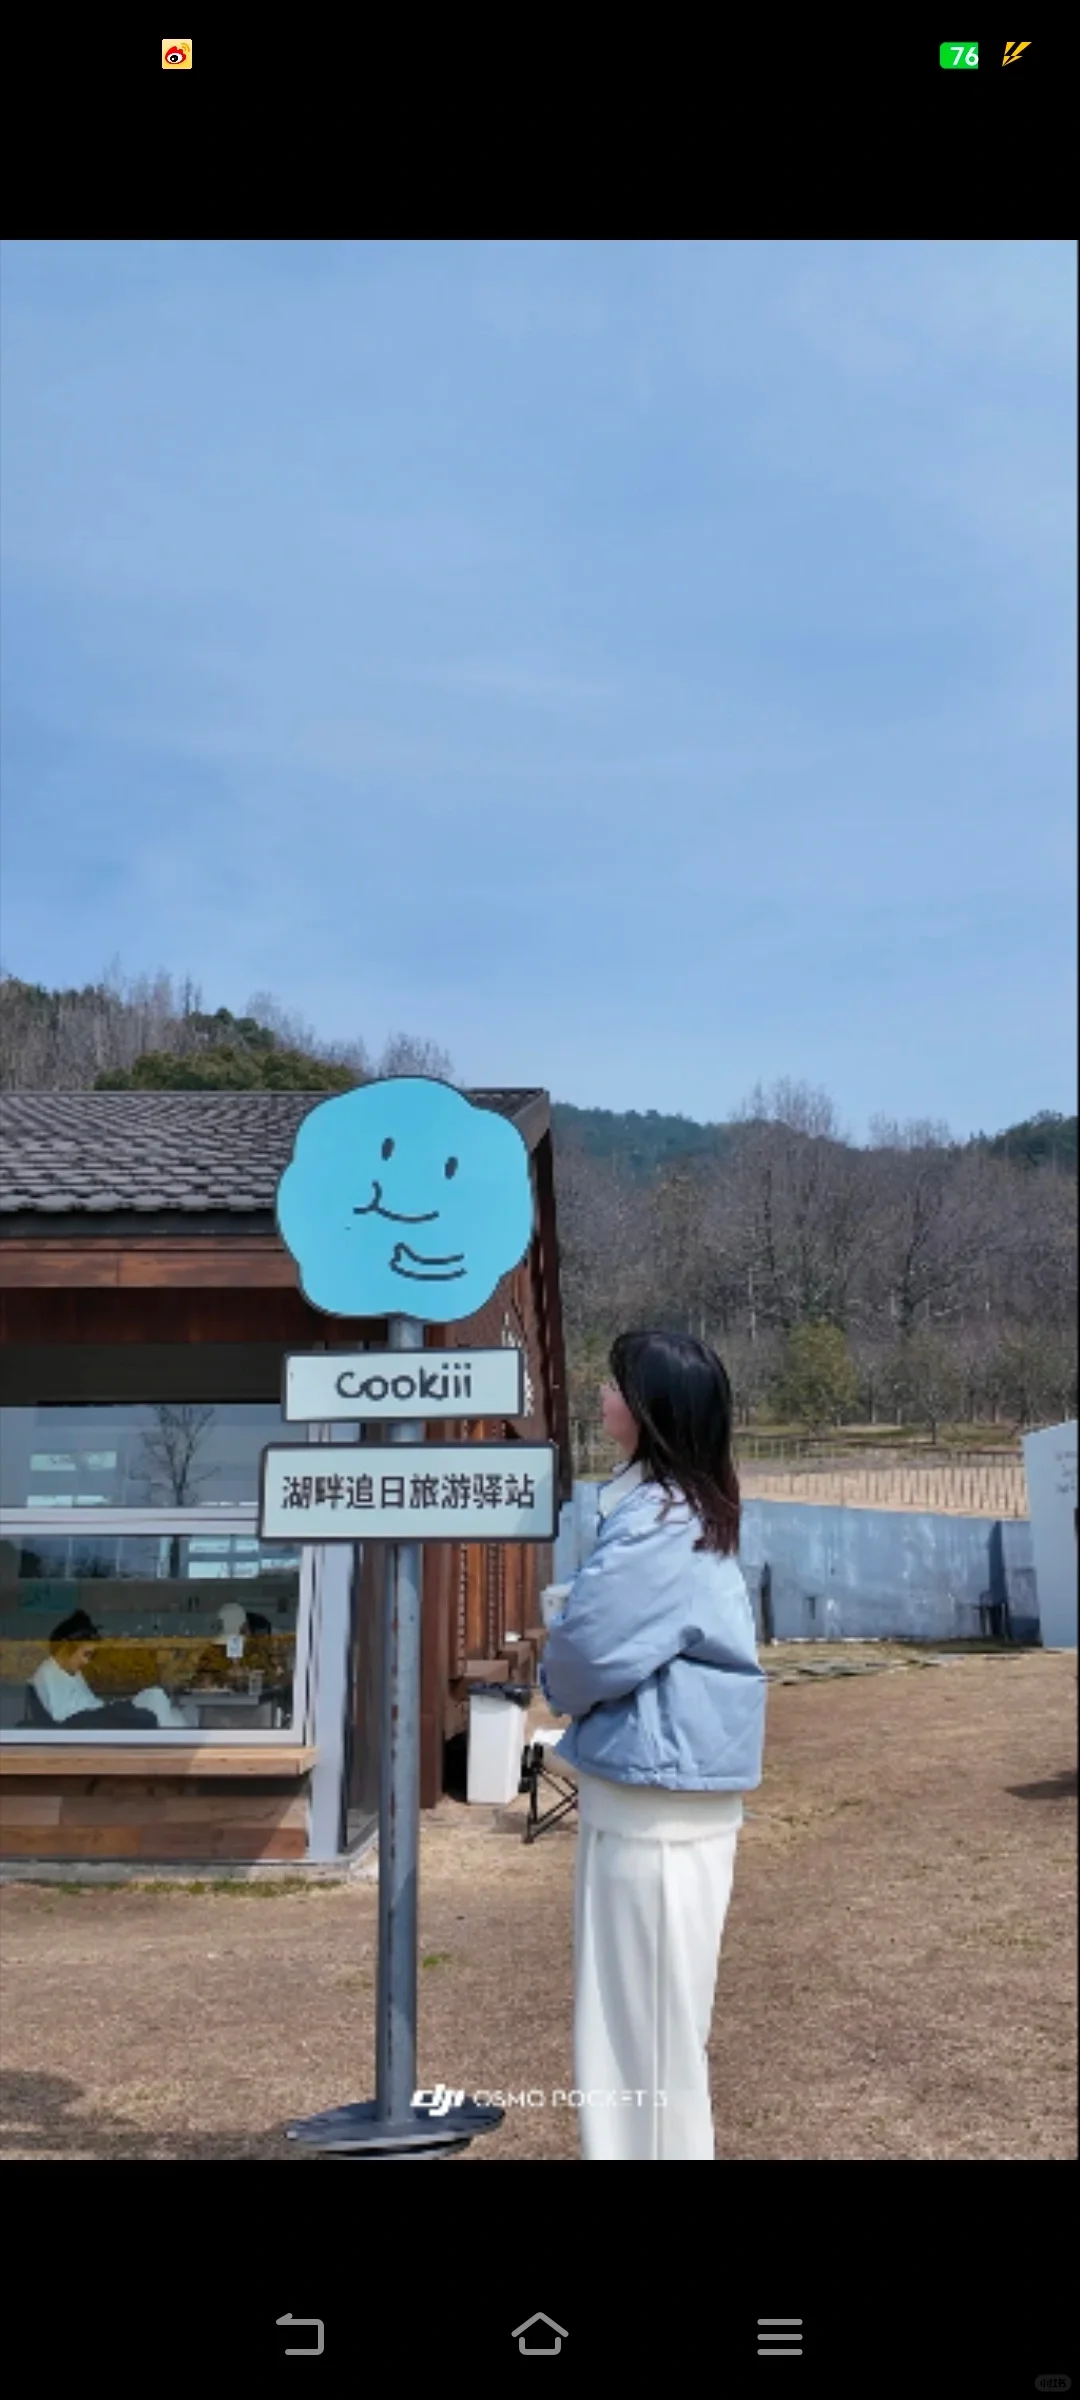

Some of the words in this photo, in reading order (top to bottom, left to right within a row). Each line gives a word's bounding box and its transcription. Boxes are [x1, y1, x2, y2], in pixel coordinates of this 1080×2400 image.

[281, 1473, 535, 1510] 湖畔追日旅游驿站
